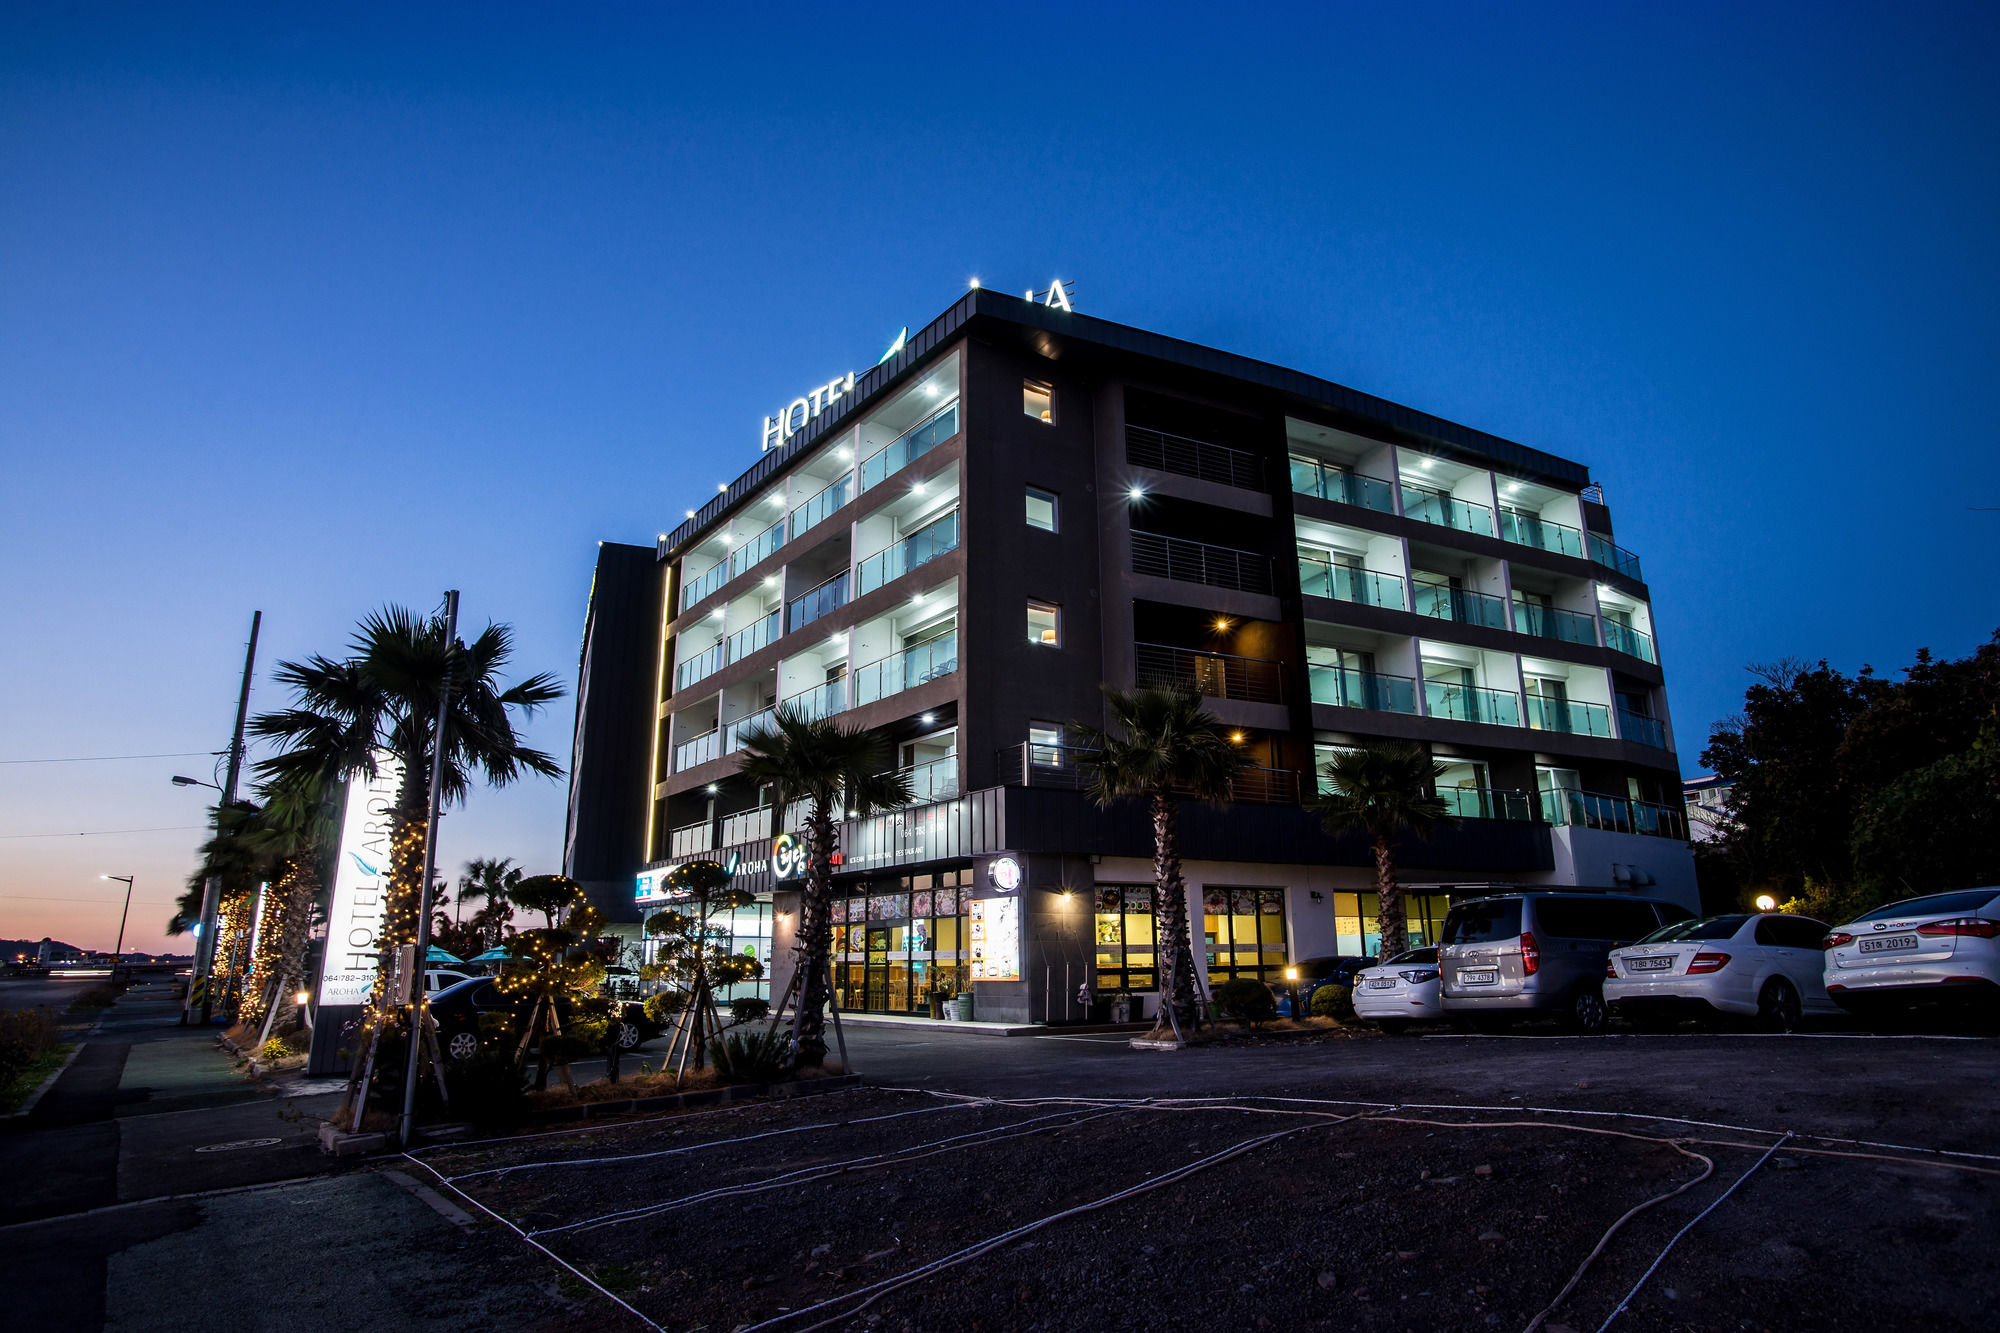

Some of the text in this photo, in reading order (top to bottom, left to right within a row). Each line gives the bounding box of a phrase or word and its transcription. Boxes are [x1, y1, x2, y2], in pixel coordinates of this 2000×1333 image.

[362, 757, 395, 856] AROHA
[896, 846, 924, 857] RESTAURANT
[735, 859, 768, 877] AROHA
[344, 879, 380, 971] HOTEL
[1886, 938, 1910, 948] 2019
[1649, 959, 1667, 967] 7543
[327, 987, 359, 996] AROHA
